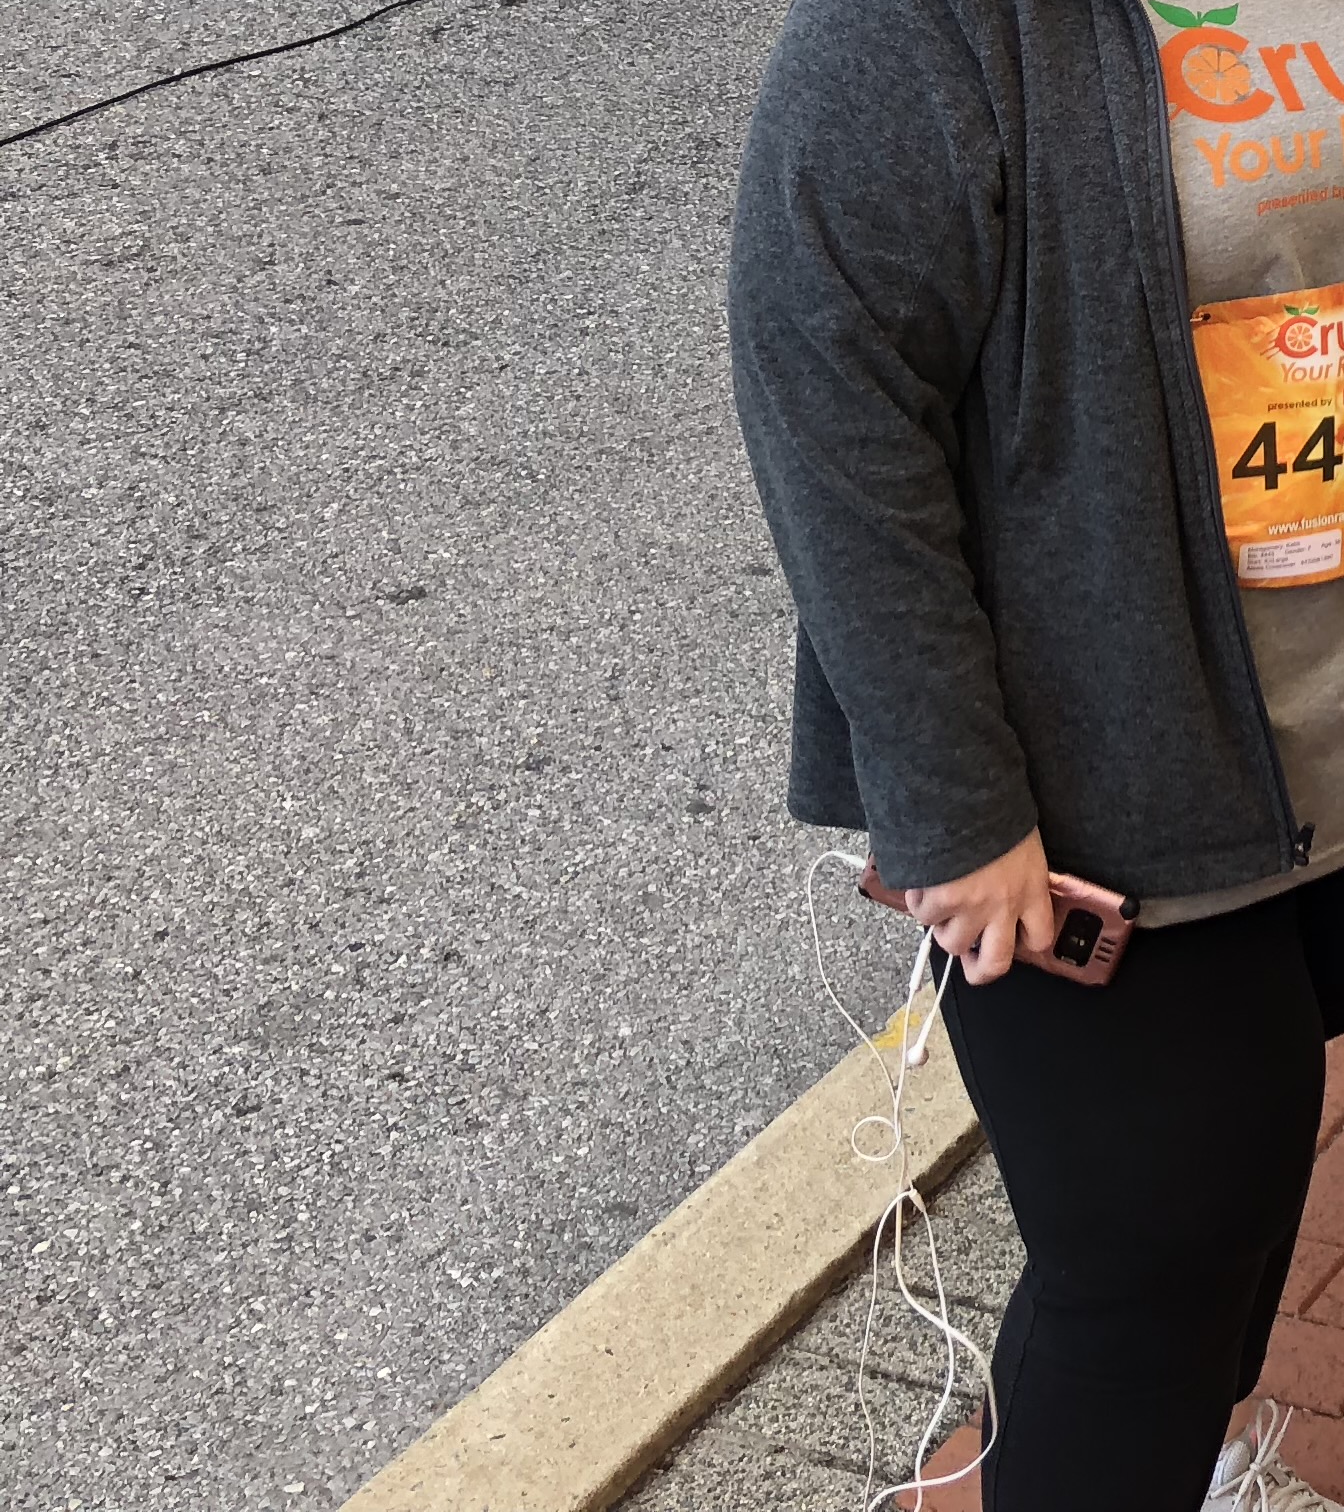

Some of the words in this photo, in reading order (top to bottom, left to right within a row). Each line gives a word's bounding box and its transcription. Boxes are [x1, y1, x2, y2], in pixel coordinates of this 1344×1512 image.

[1193, 128, 1327, 188] Your
[1281, 362, 1333, 383] Your
[1267, 399, 1318, 413] presented
[1320, 398, 1333, 409] by
